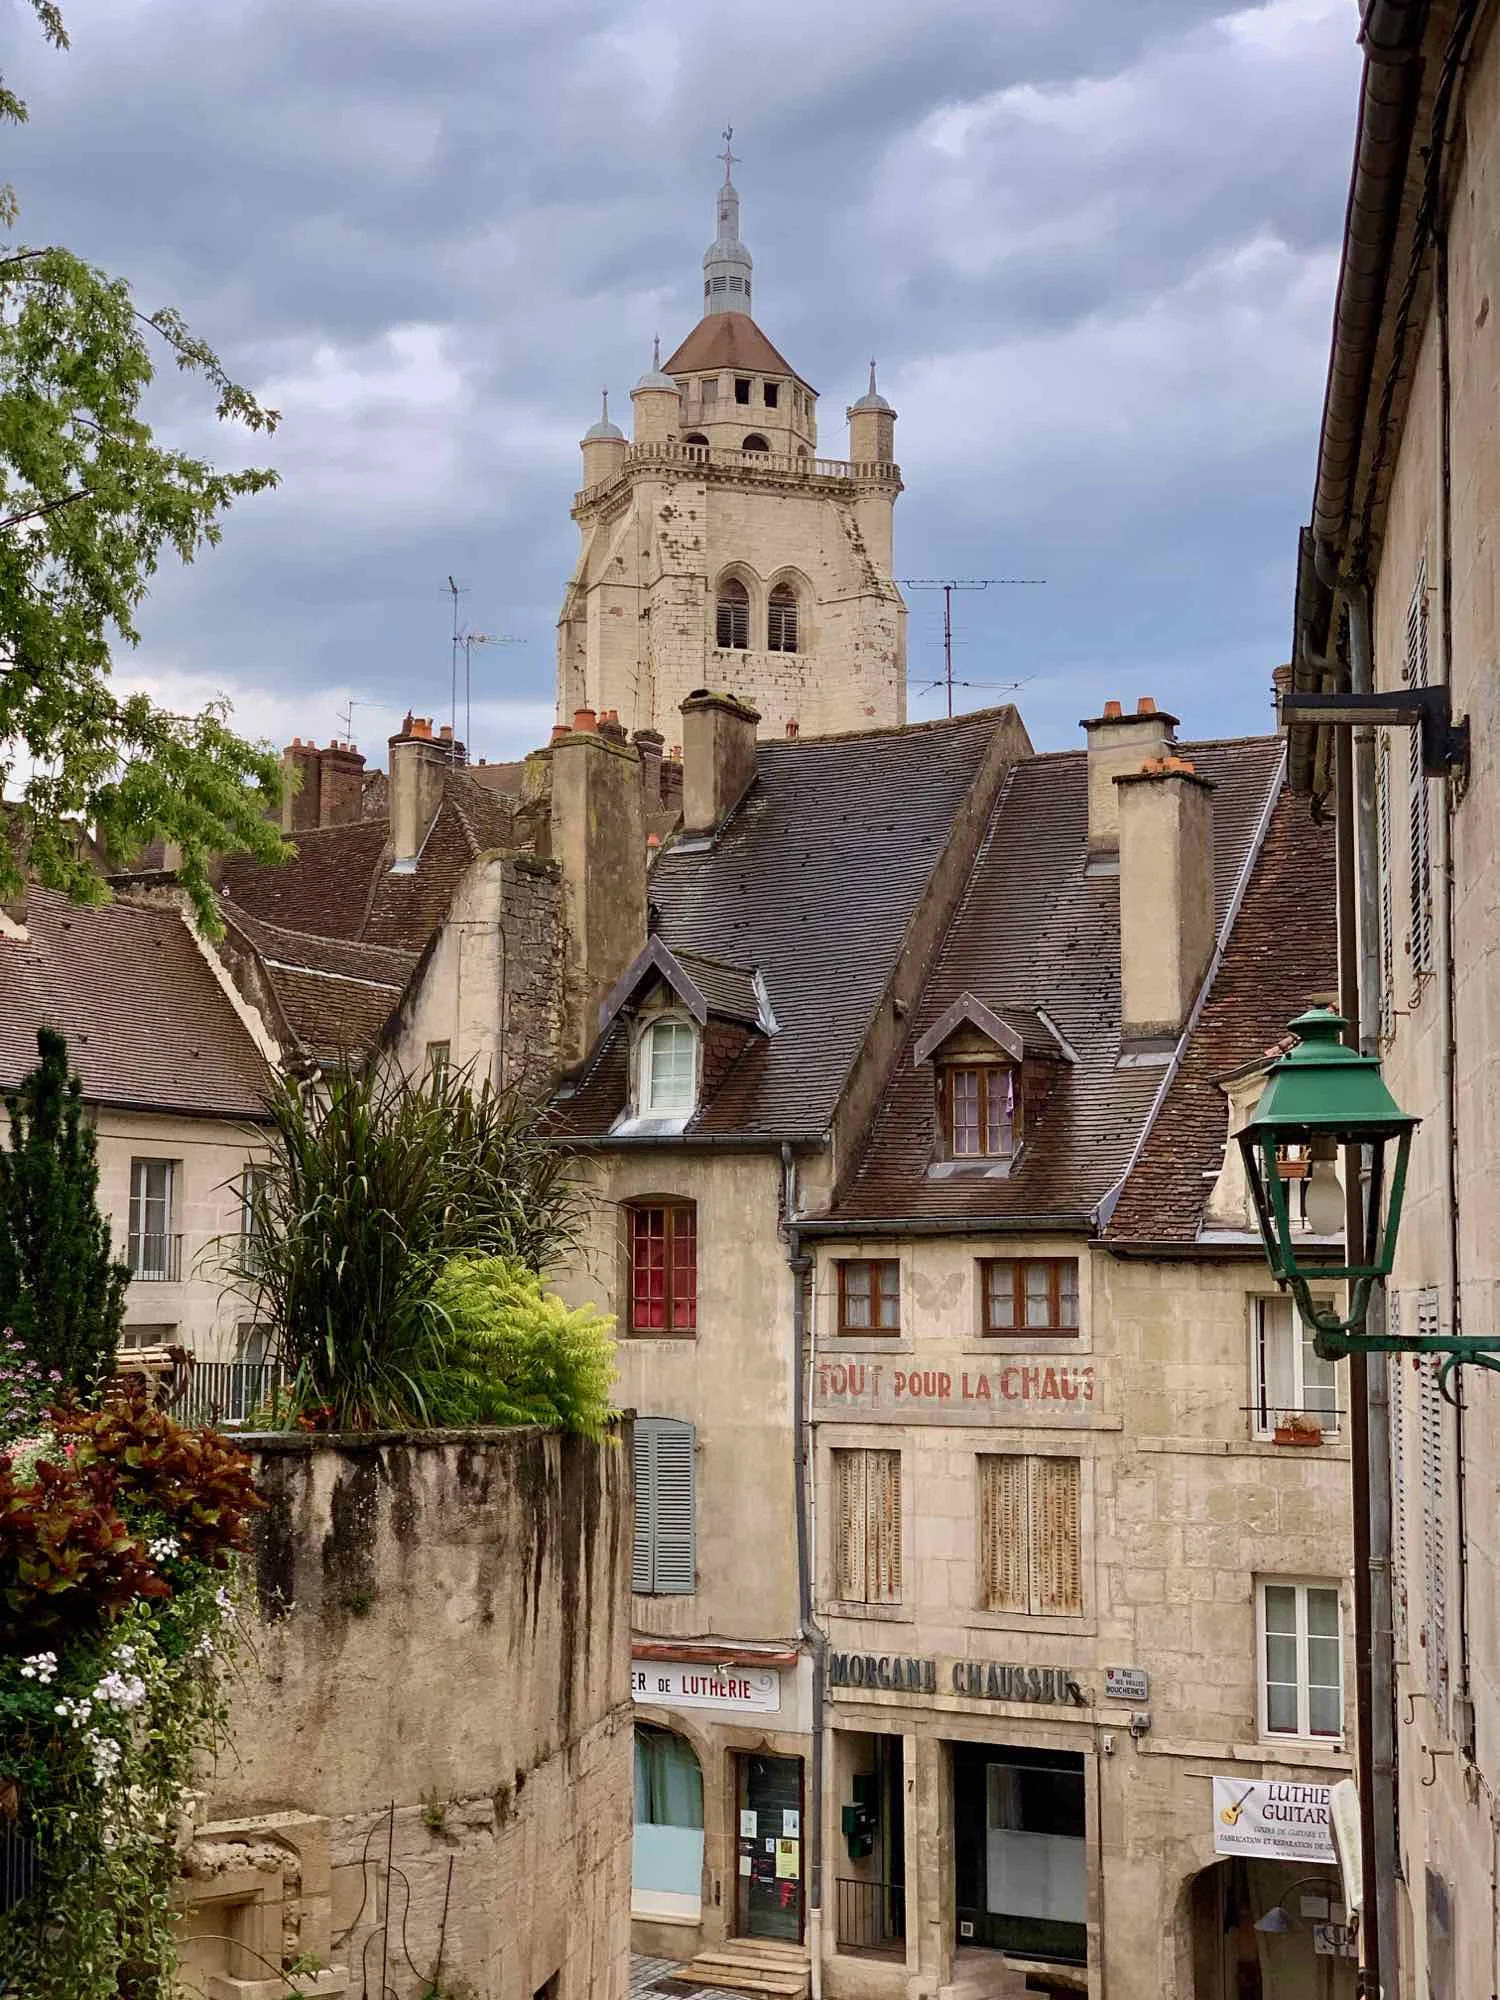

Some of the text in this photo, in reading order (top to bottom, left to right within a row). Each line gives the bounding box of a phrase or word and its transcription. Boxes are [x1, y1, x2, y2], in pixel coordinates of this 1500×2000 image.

[819, 1363, 882, 1396] TOUT
[895, 1371, 951, 1397] POUR
[962, 1372, 991, 1399] LA
[658, 1678, 671, 1692] DE
[682, 1675, 751, 1699] LUTHERIE
[908, 1780, 914, 1792] 7
